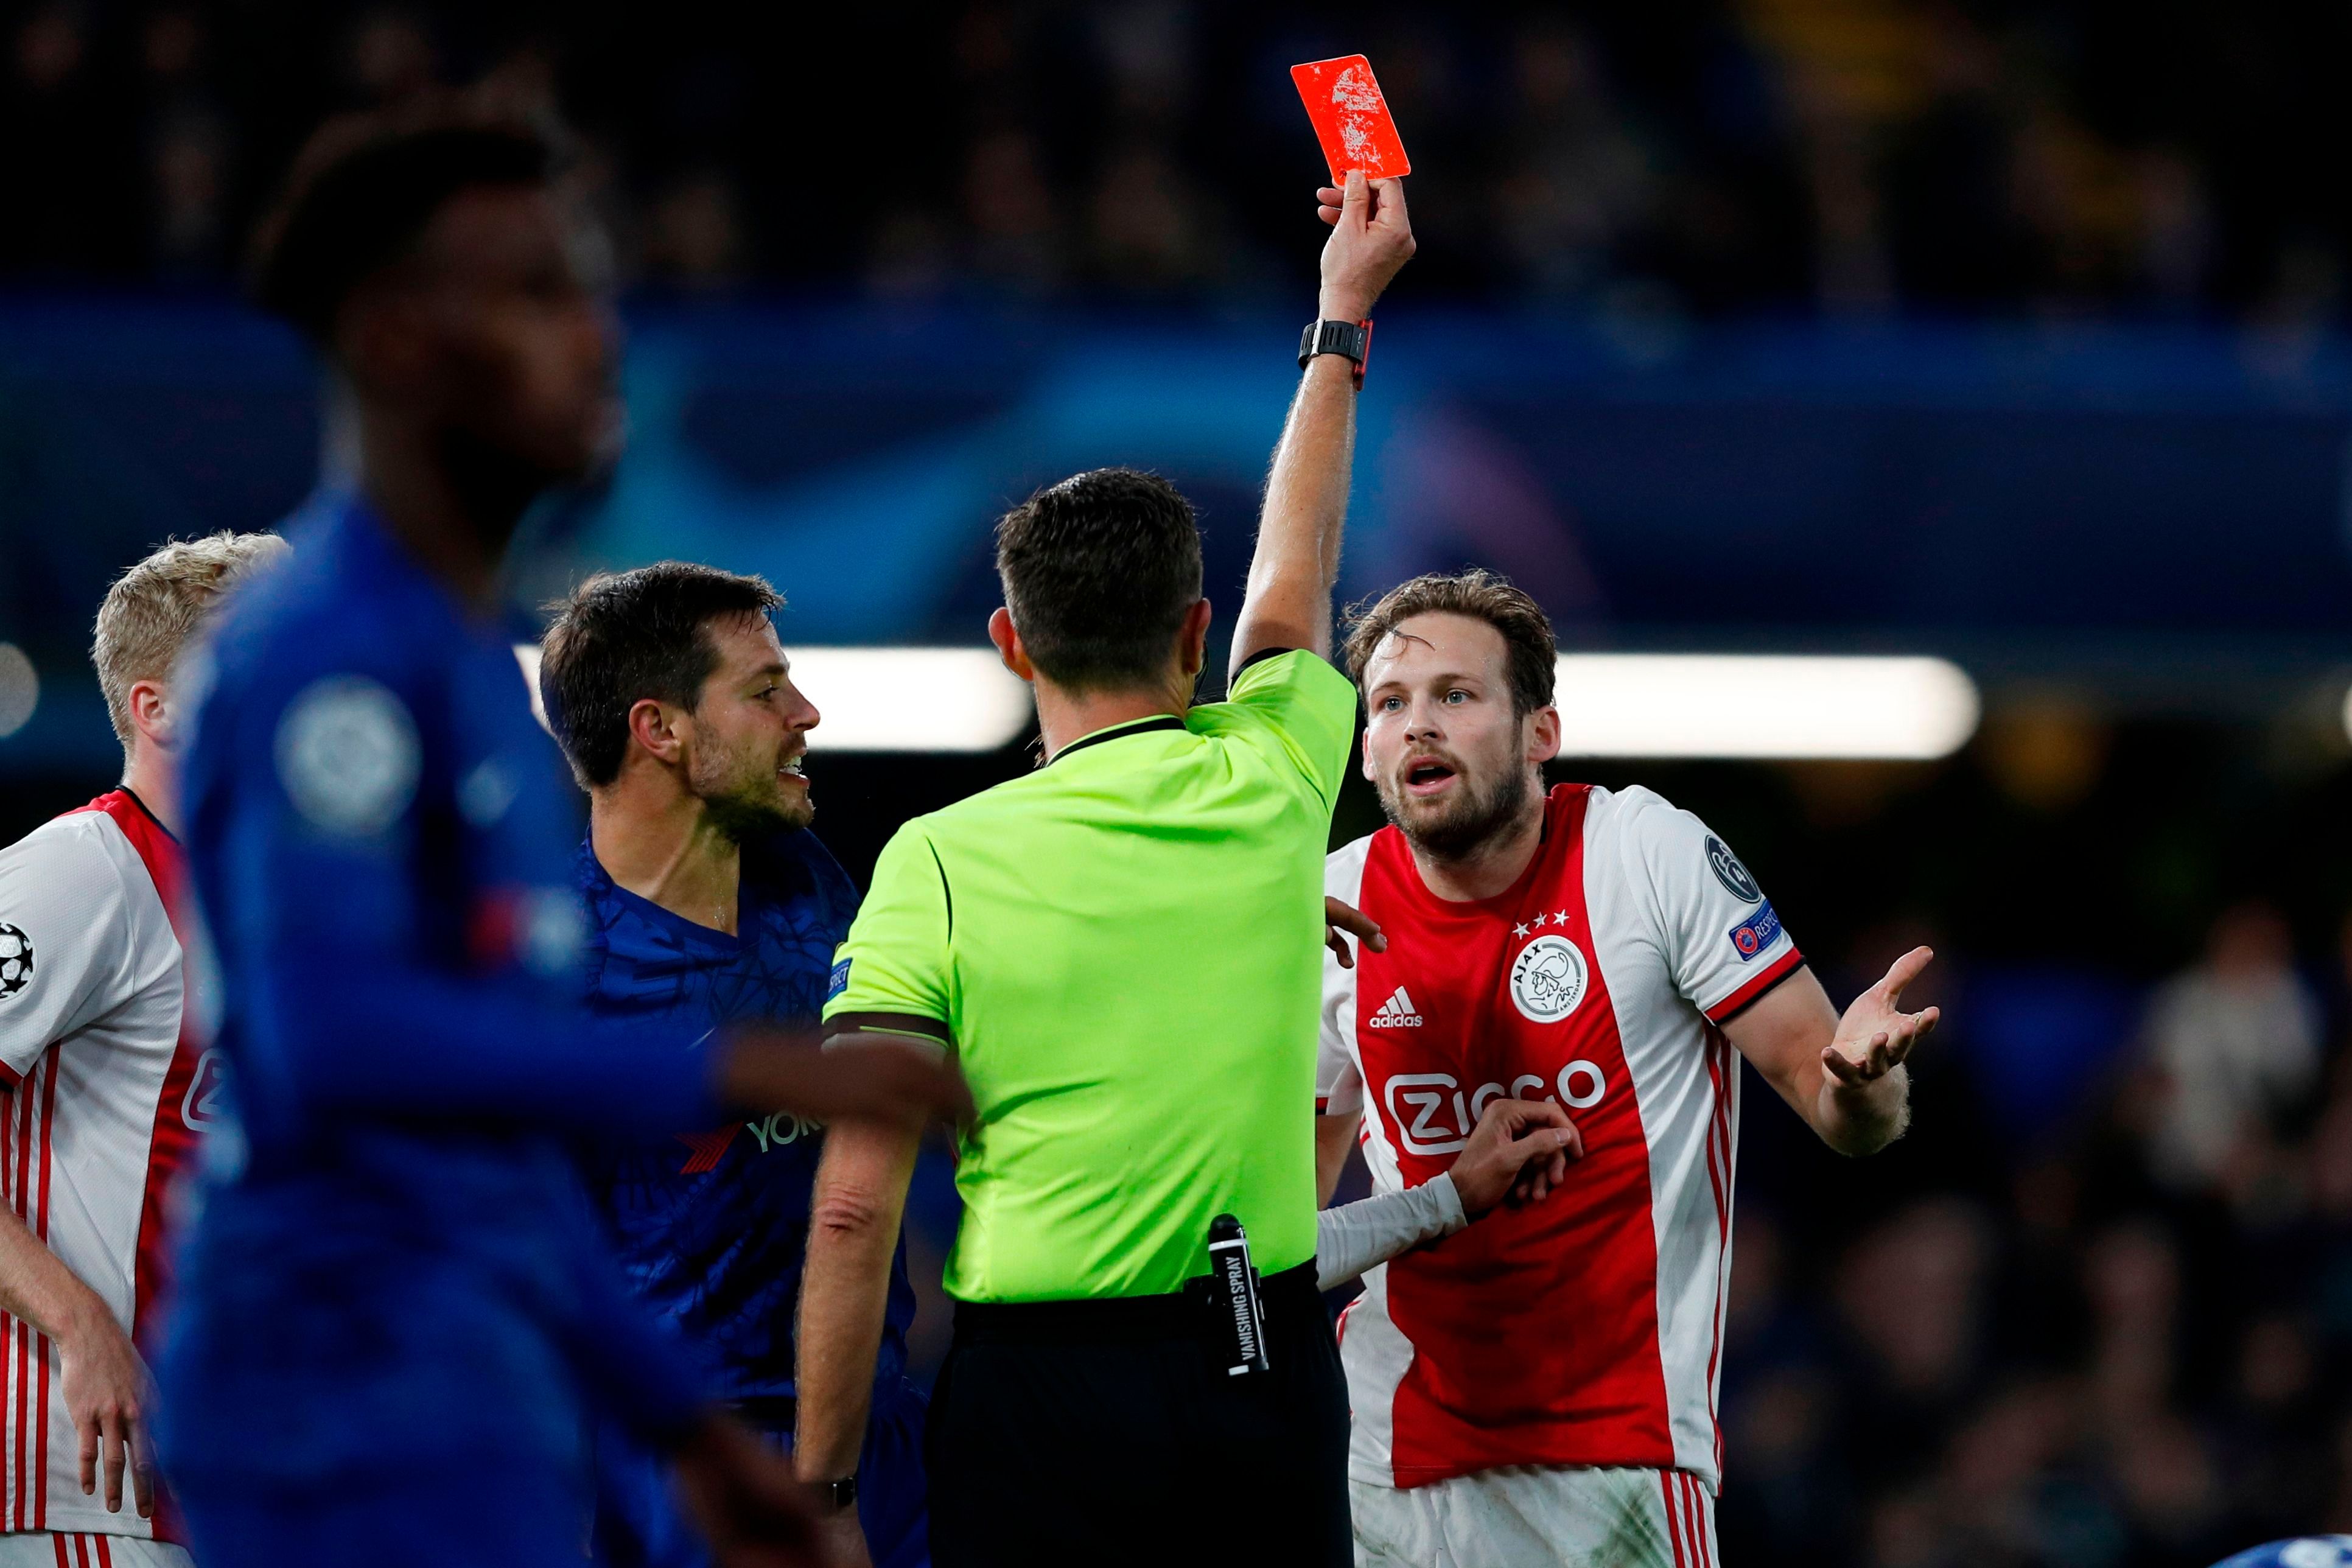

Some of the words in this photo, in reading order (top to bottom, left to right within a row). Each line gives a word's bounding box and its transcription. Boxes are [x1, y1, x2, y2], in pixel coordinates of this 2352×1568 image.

[1754, 907, 1778, 940] RESPEC
[1513, 944, 1541, 984] AJAX
[1559, 978, 1581, 1012] AMSTERDAM
[1369, 1014, 1423, 1028] adidas
[1225, 1256, 1245, 1294] SPRAY
[1233, 1294, 1256, 1360] VANISHING
